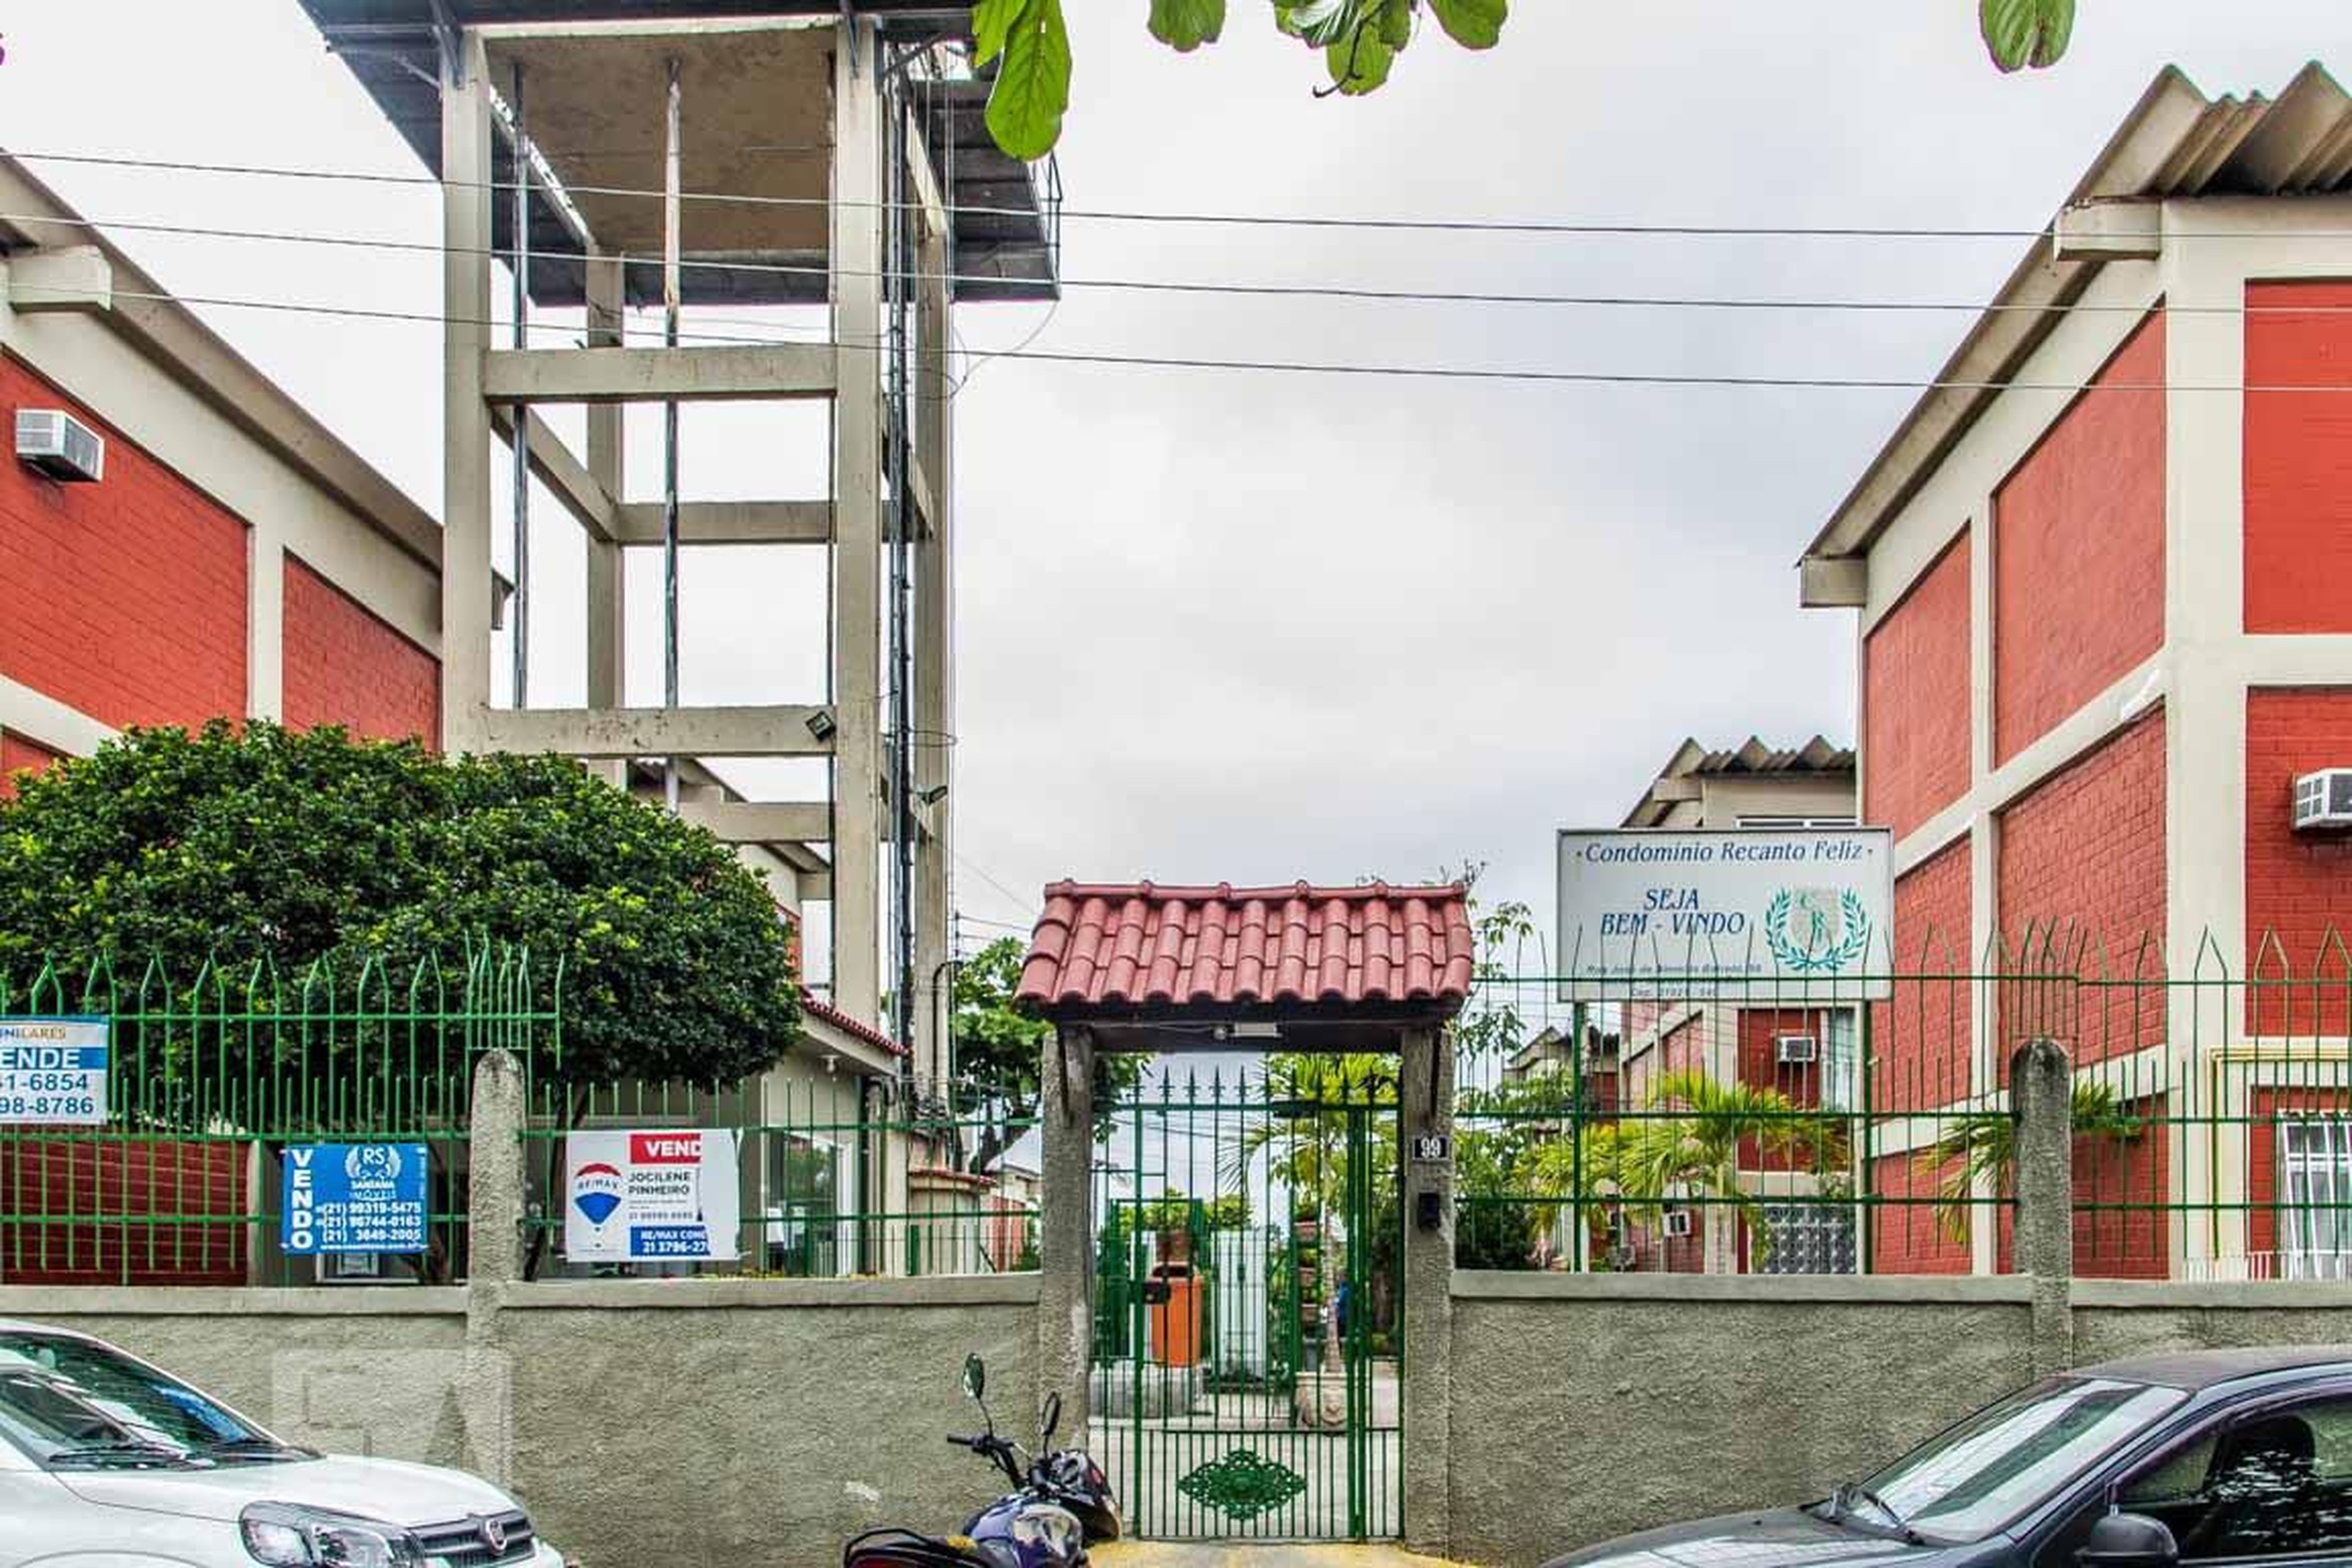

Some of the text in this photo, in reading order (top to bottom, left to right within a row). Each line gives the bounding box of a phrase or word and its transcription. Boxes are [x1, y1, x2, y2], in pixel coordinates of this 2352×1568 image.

[1721, 840, 1806, 861] Recanto
[1814, 840, 1863, 861] Feliz
[1643, 888, 1699, 911] SEJA
[1600, 913, 1648, 935] BEM
[1673, 911, 1745, 935] VINDO
[0, 1073, 88, 1091] 1-6854
[363, 1147, 385, 1164] RS
[1421, 1137, 1440, 1158] 99
[629, 1171, 691, 1183] JOCILENE
[291, 1149, 314, 1249] VENDO
[629, 1184, 690, 1195] PINHEIRO
